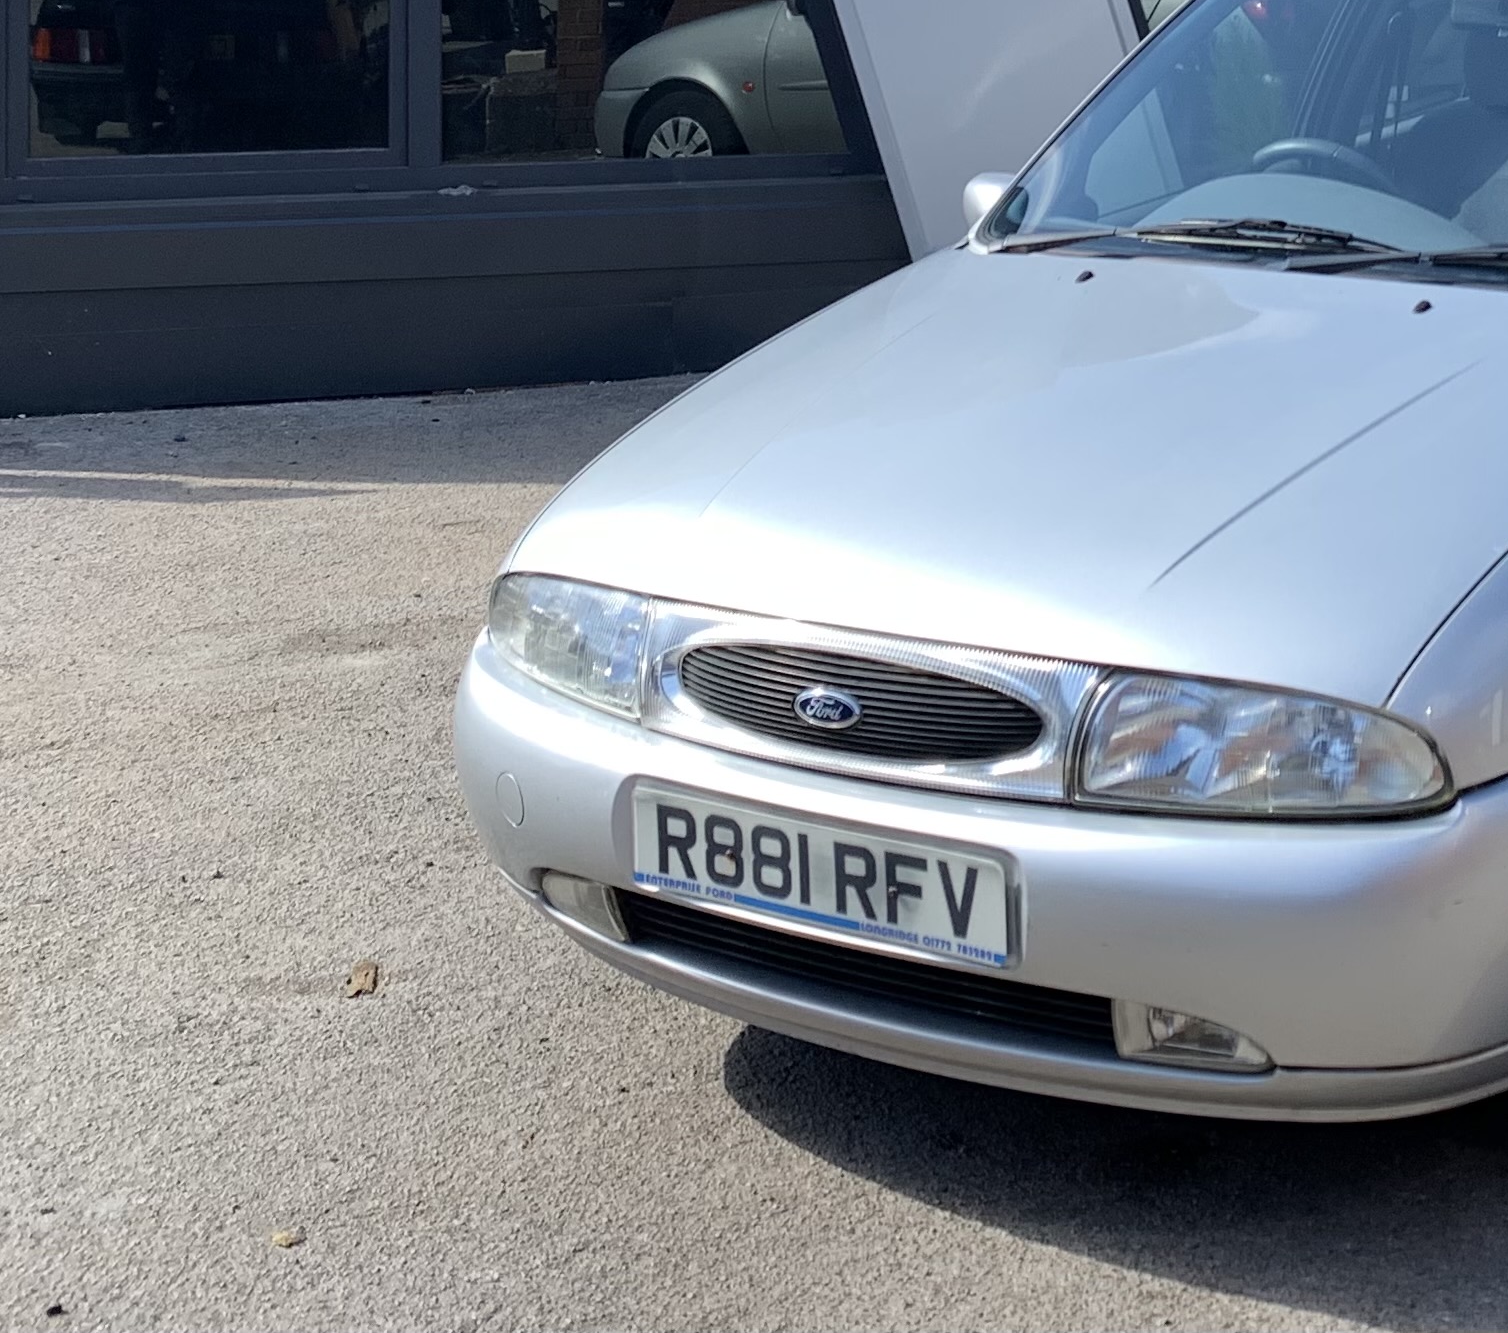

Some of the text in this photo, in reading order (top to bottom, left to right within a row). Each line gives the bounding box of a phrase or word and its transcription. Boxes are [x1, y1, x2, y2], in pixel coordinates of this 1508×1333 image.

[806, 697, 844, 721] Ford
[657, 804, 978, 939] R881 RFV
[646, 873, 734, 901] ENTERPRISE FORD
[860, 922, 919, 944] LONGRIDGE
